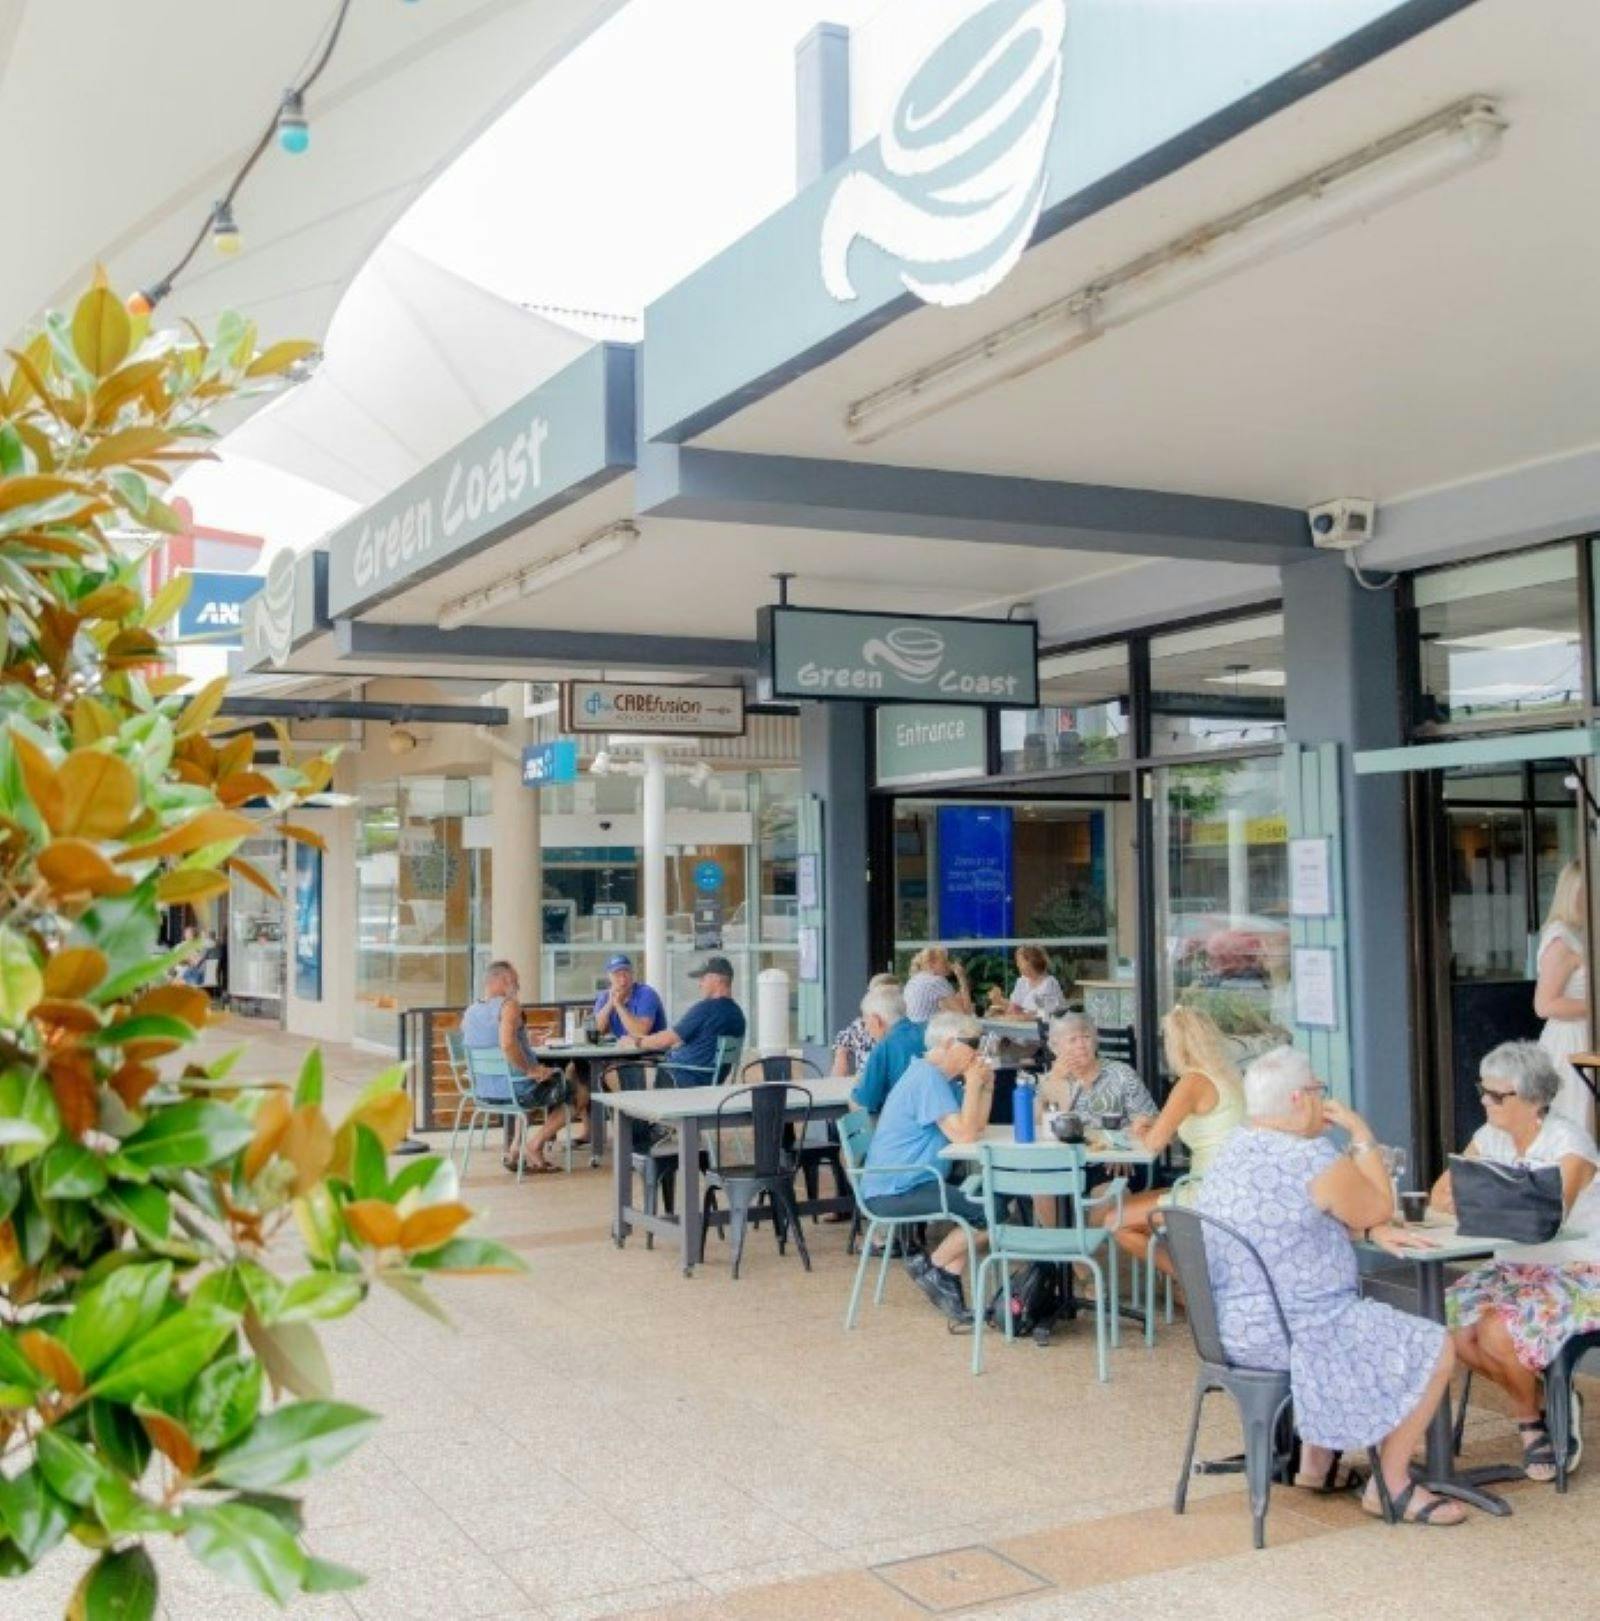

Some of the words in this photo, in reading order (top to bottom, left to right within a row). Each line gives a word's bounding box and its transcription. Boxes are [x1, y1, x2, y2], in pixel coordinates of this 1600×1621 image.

[353, 499, 433, 588] Green
[443, 416, 549, 537] Coast
[195, 601, 241, 624] AN
[798, 661, 883, 689] Green
[938, 669, 1018, 695] Coast
[897, 718, 966, 746] Entrance
